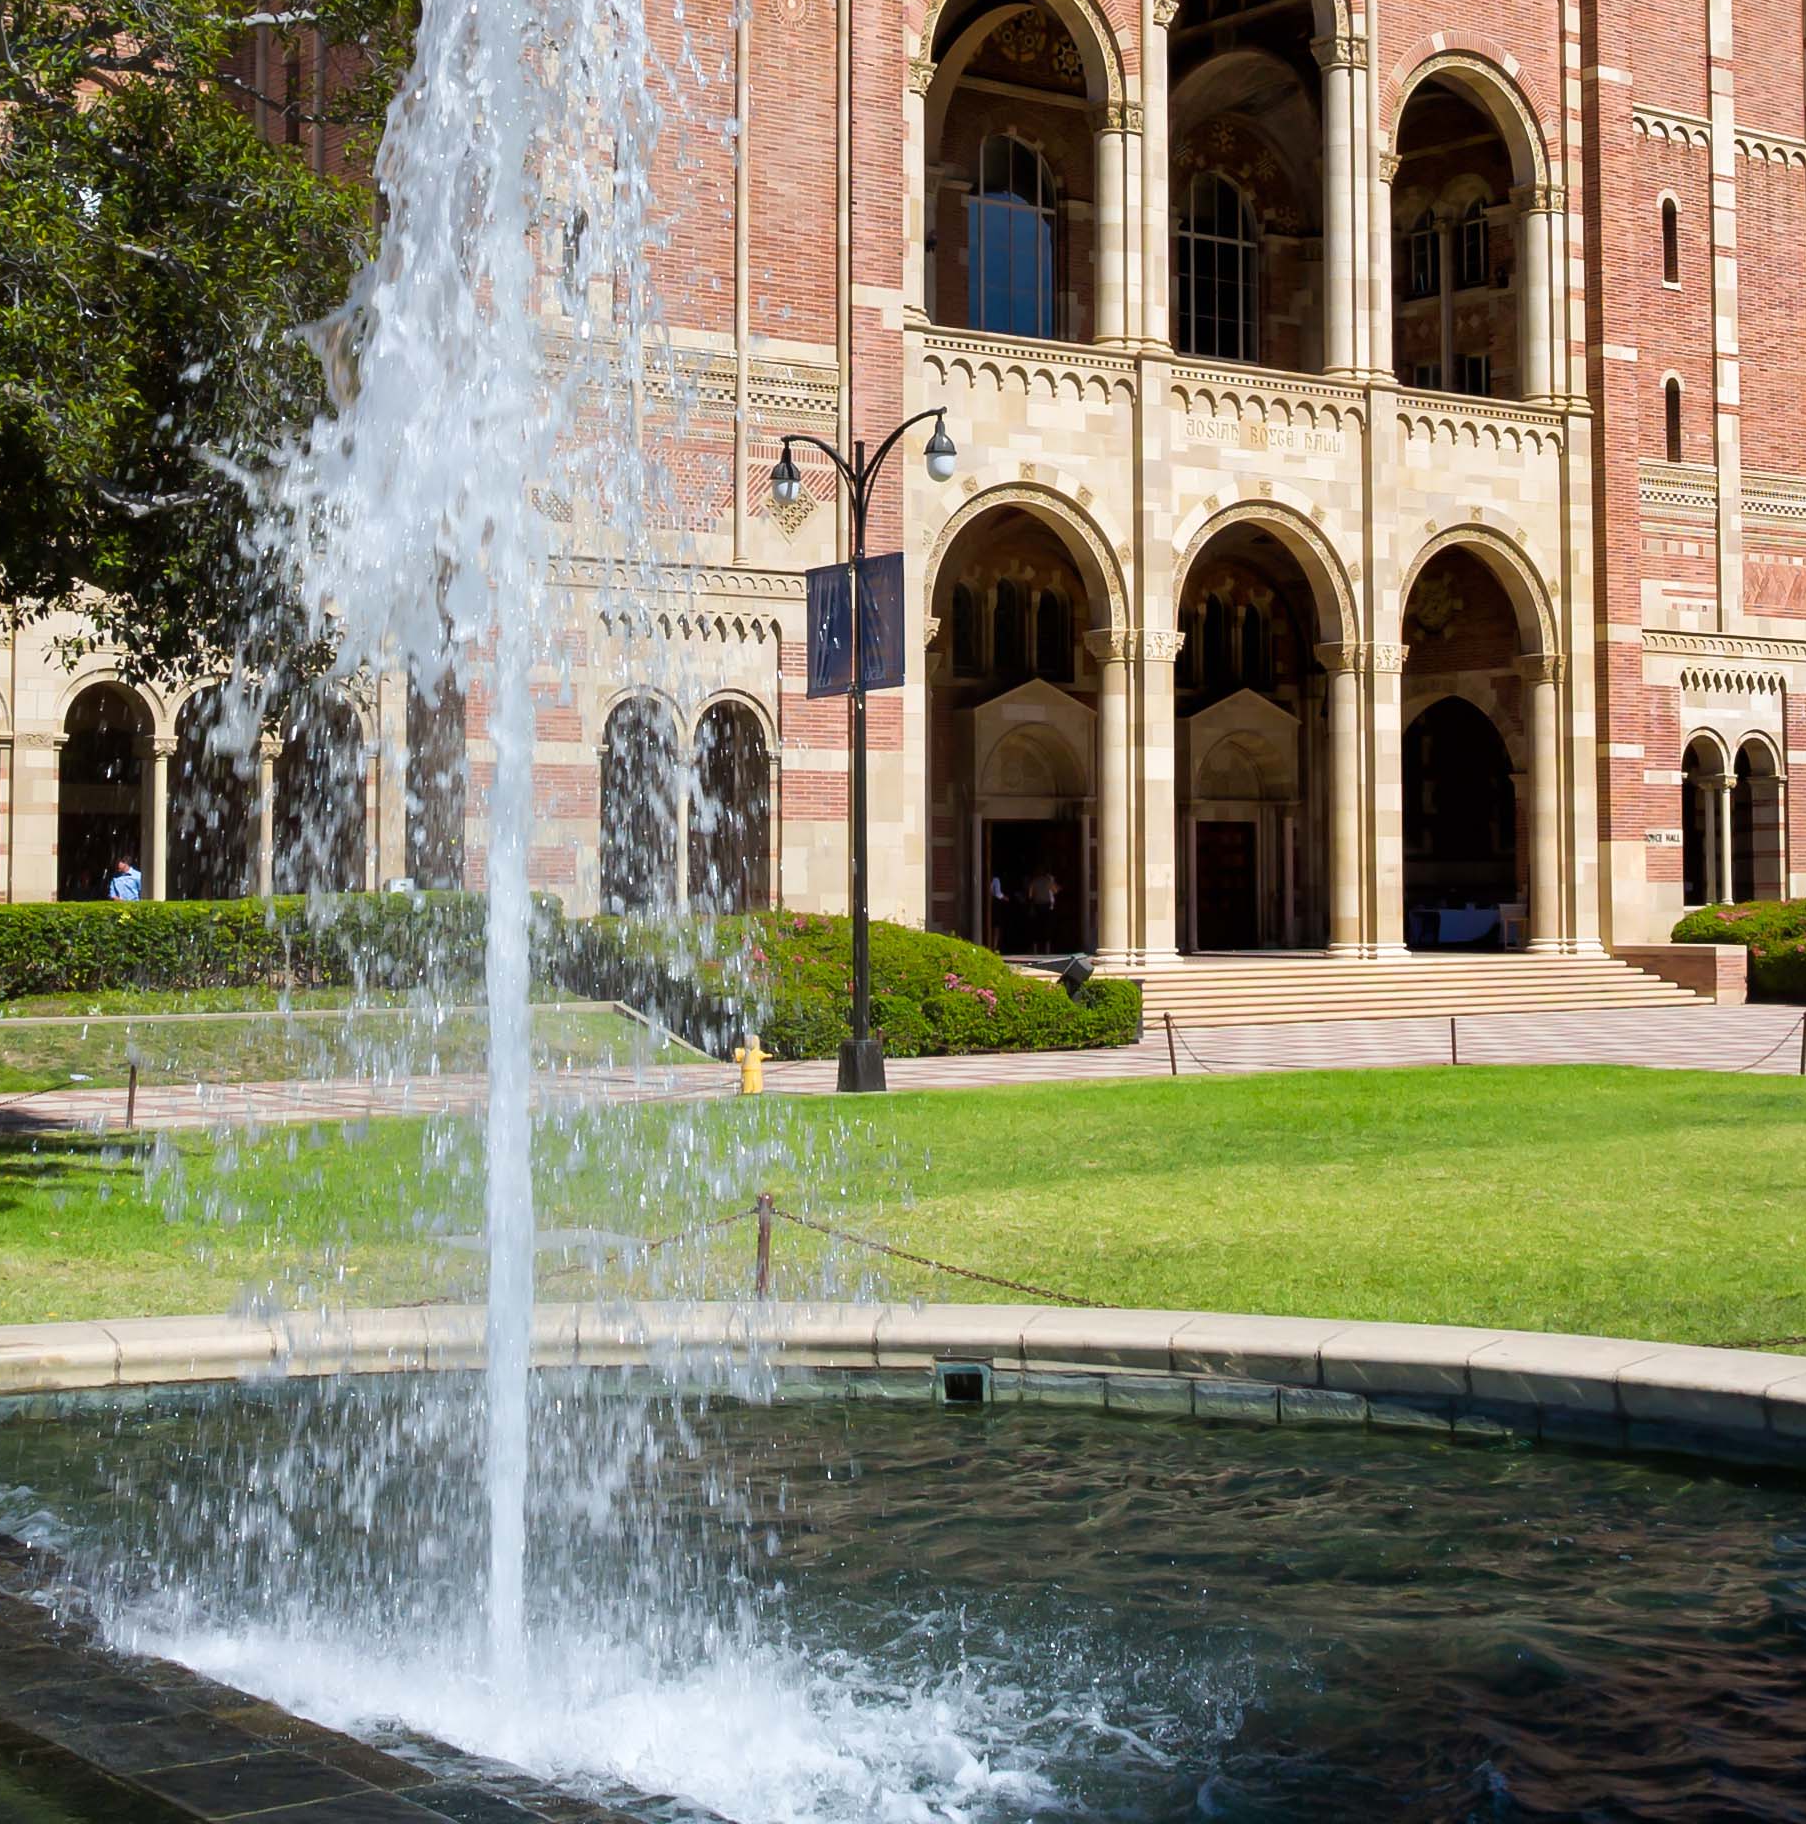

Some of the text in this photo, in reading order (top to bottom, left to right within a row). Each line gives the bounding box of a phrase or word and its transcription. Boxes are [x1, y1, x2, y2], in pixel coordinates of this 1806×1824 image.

[1186, 418, 1341, 453] JOSIAH ROYCE HALL
[864, 668, 887, 681] UCLA
